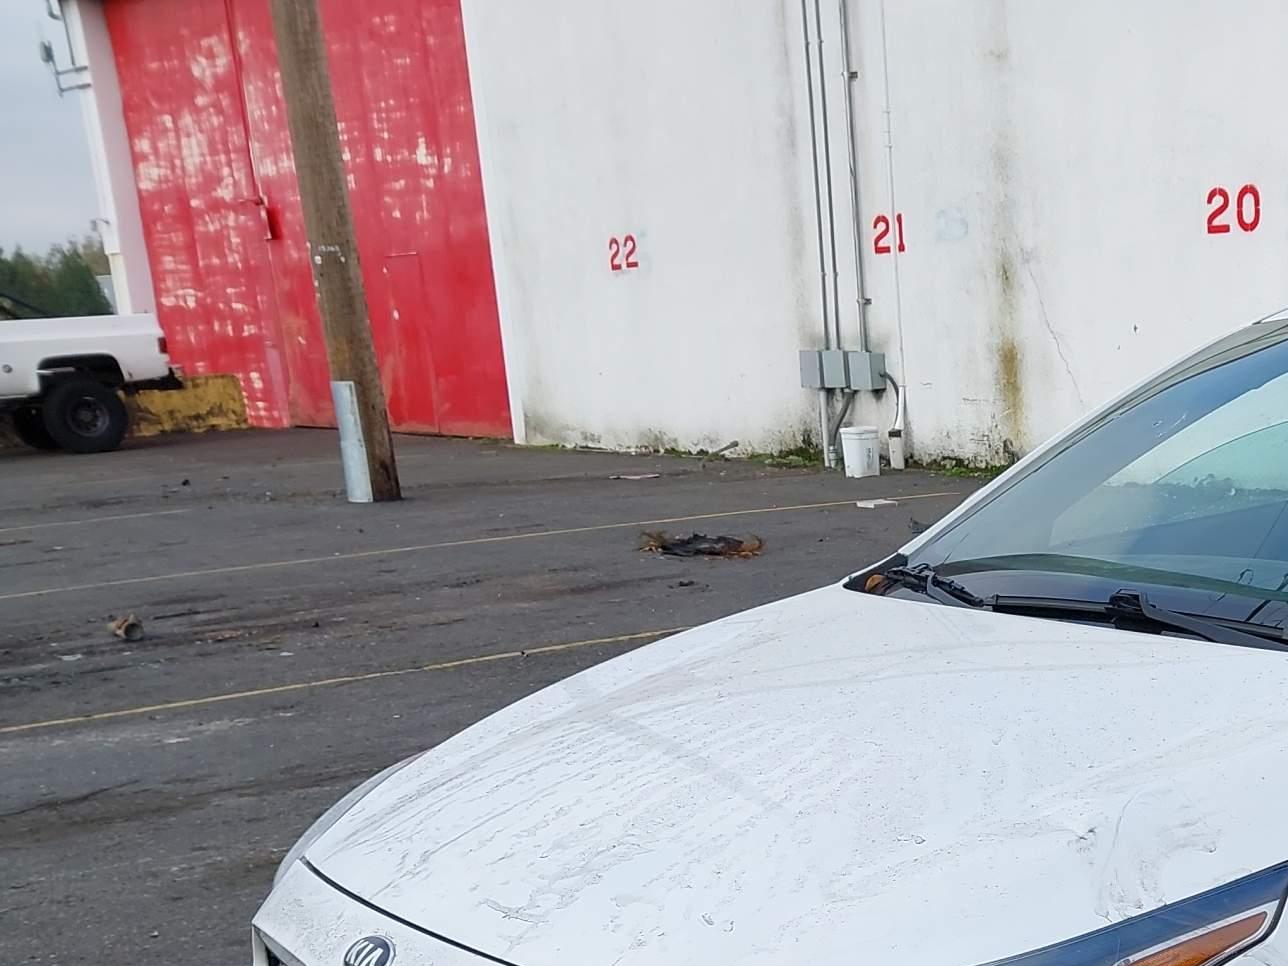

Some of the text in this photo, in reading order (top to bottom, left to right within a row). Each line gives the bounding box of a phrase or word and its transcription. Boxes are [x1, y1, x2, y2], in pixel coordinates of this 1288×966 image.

[1206, 184, 1261, 234] 20
[608, 234, 640, 271] 22
[873, 213, 906, 254] 21
